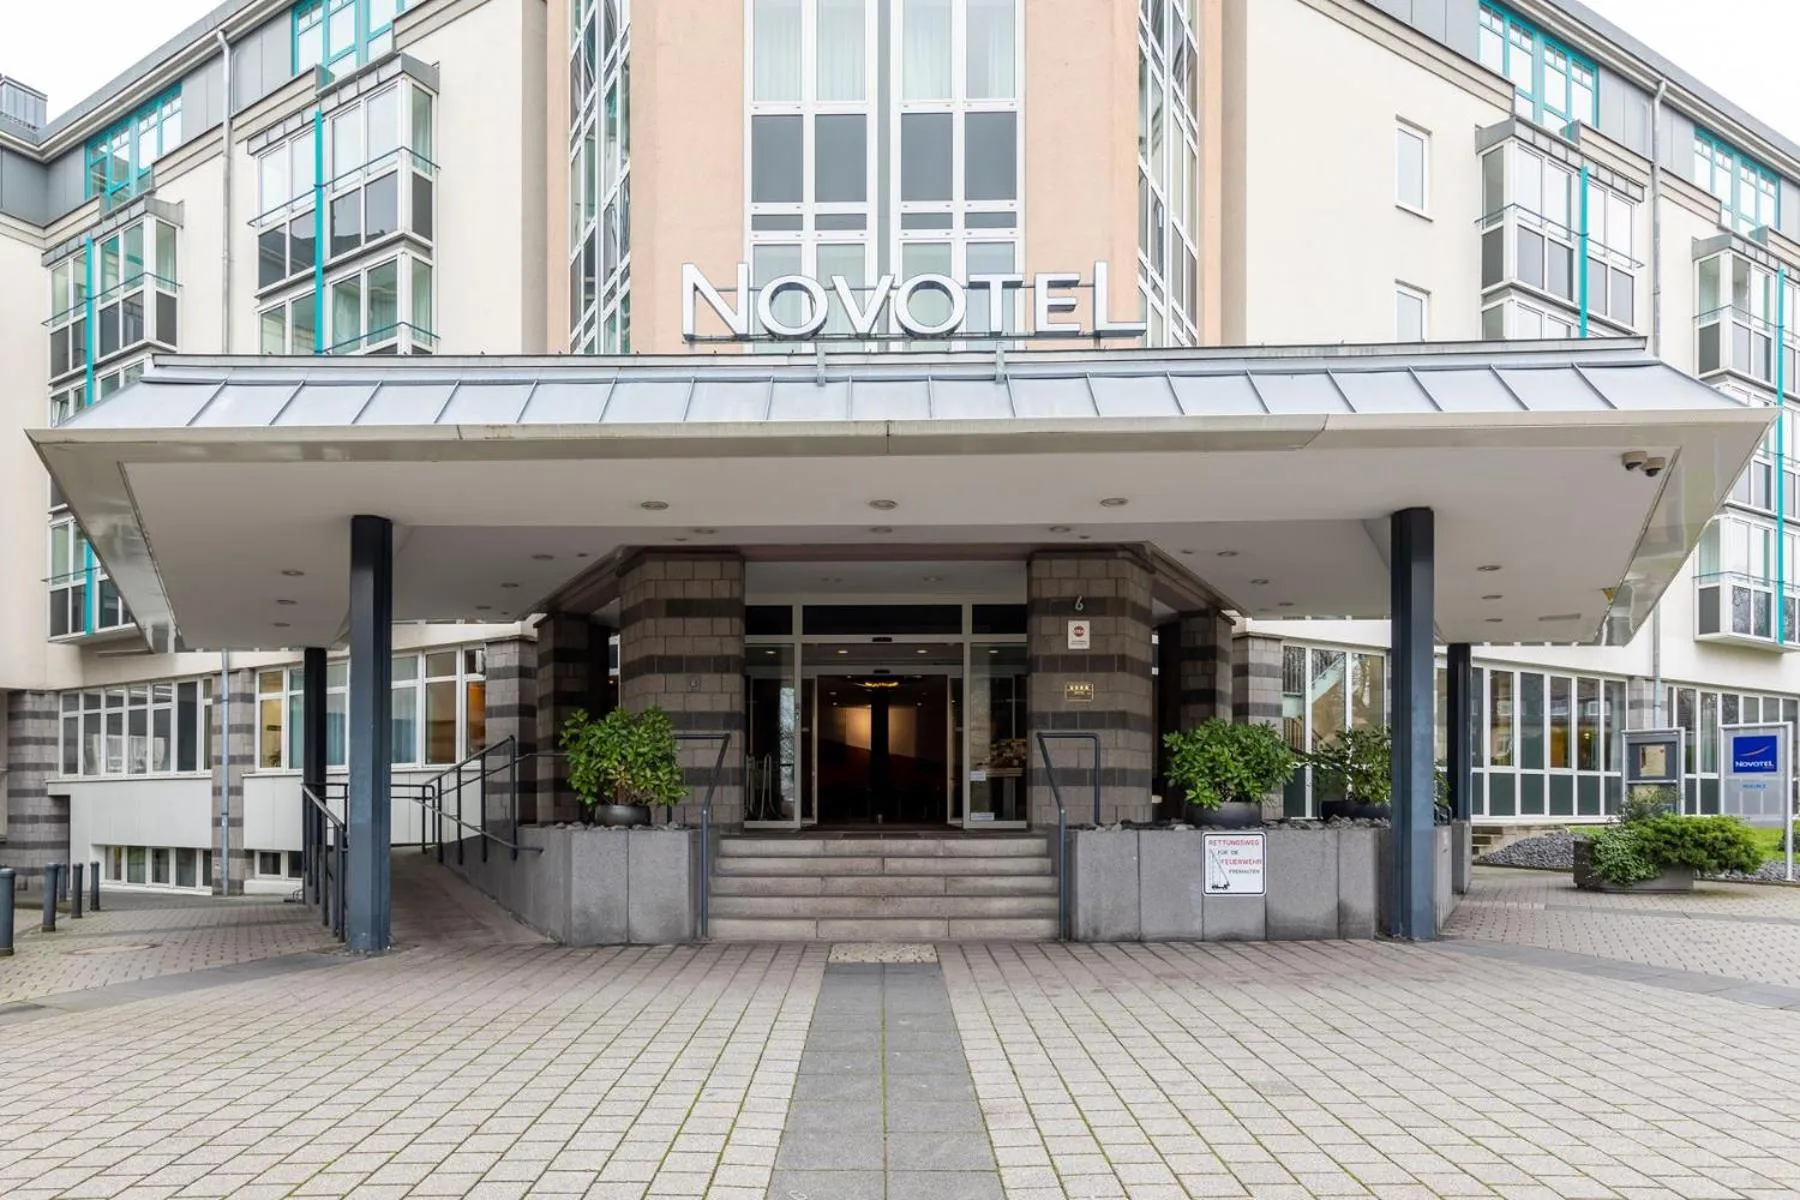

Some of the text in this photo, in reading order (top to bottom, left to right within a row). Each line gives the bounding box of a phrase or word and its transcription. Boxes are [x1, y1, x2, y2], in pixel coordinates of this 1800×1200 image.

[682, 261, 1147, 340] NOVOTEL
[1075, 596, 1084, 611] 6
[1735, 760, 1775, 768] NOVOTEL
